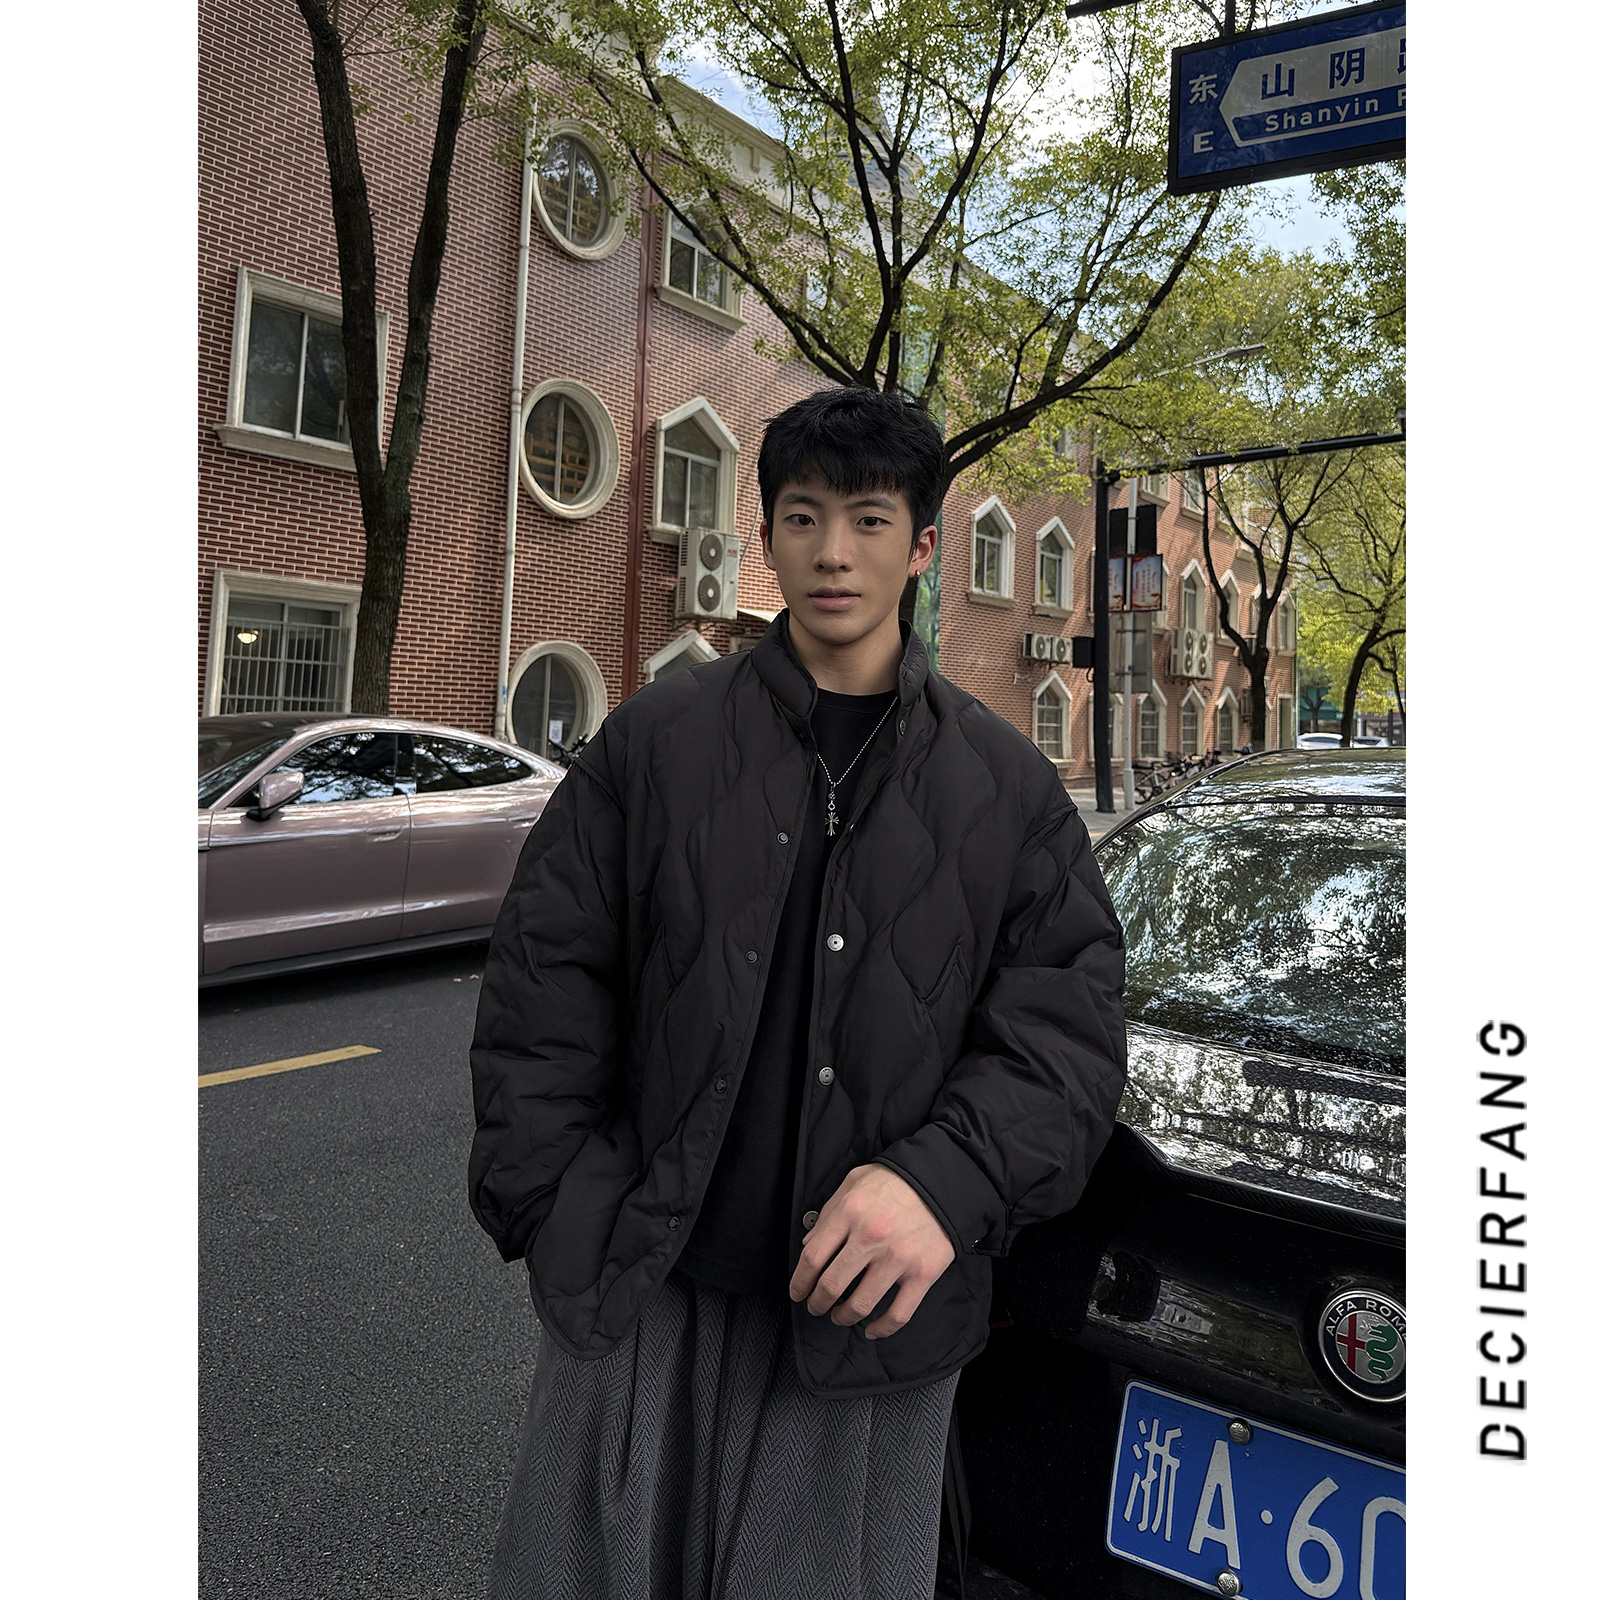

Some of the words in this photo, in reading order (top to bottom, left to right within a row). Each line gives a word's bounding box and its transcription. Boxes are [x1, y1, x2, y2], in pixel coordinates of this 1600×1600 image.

[1261, 37, 1406, 100] 山阴
[1188, 73, 1219, 105] 东
[1265, 97, 1379, 133] Shanyin
[1193, 130, 1215, 154] E
[1326, 1300, 1358, 1337] ALFA
